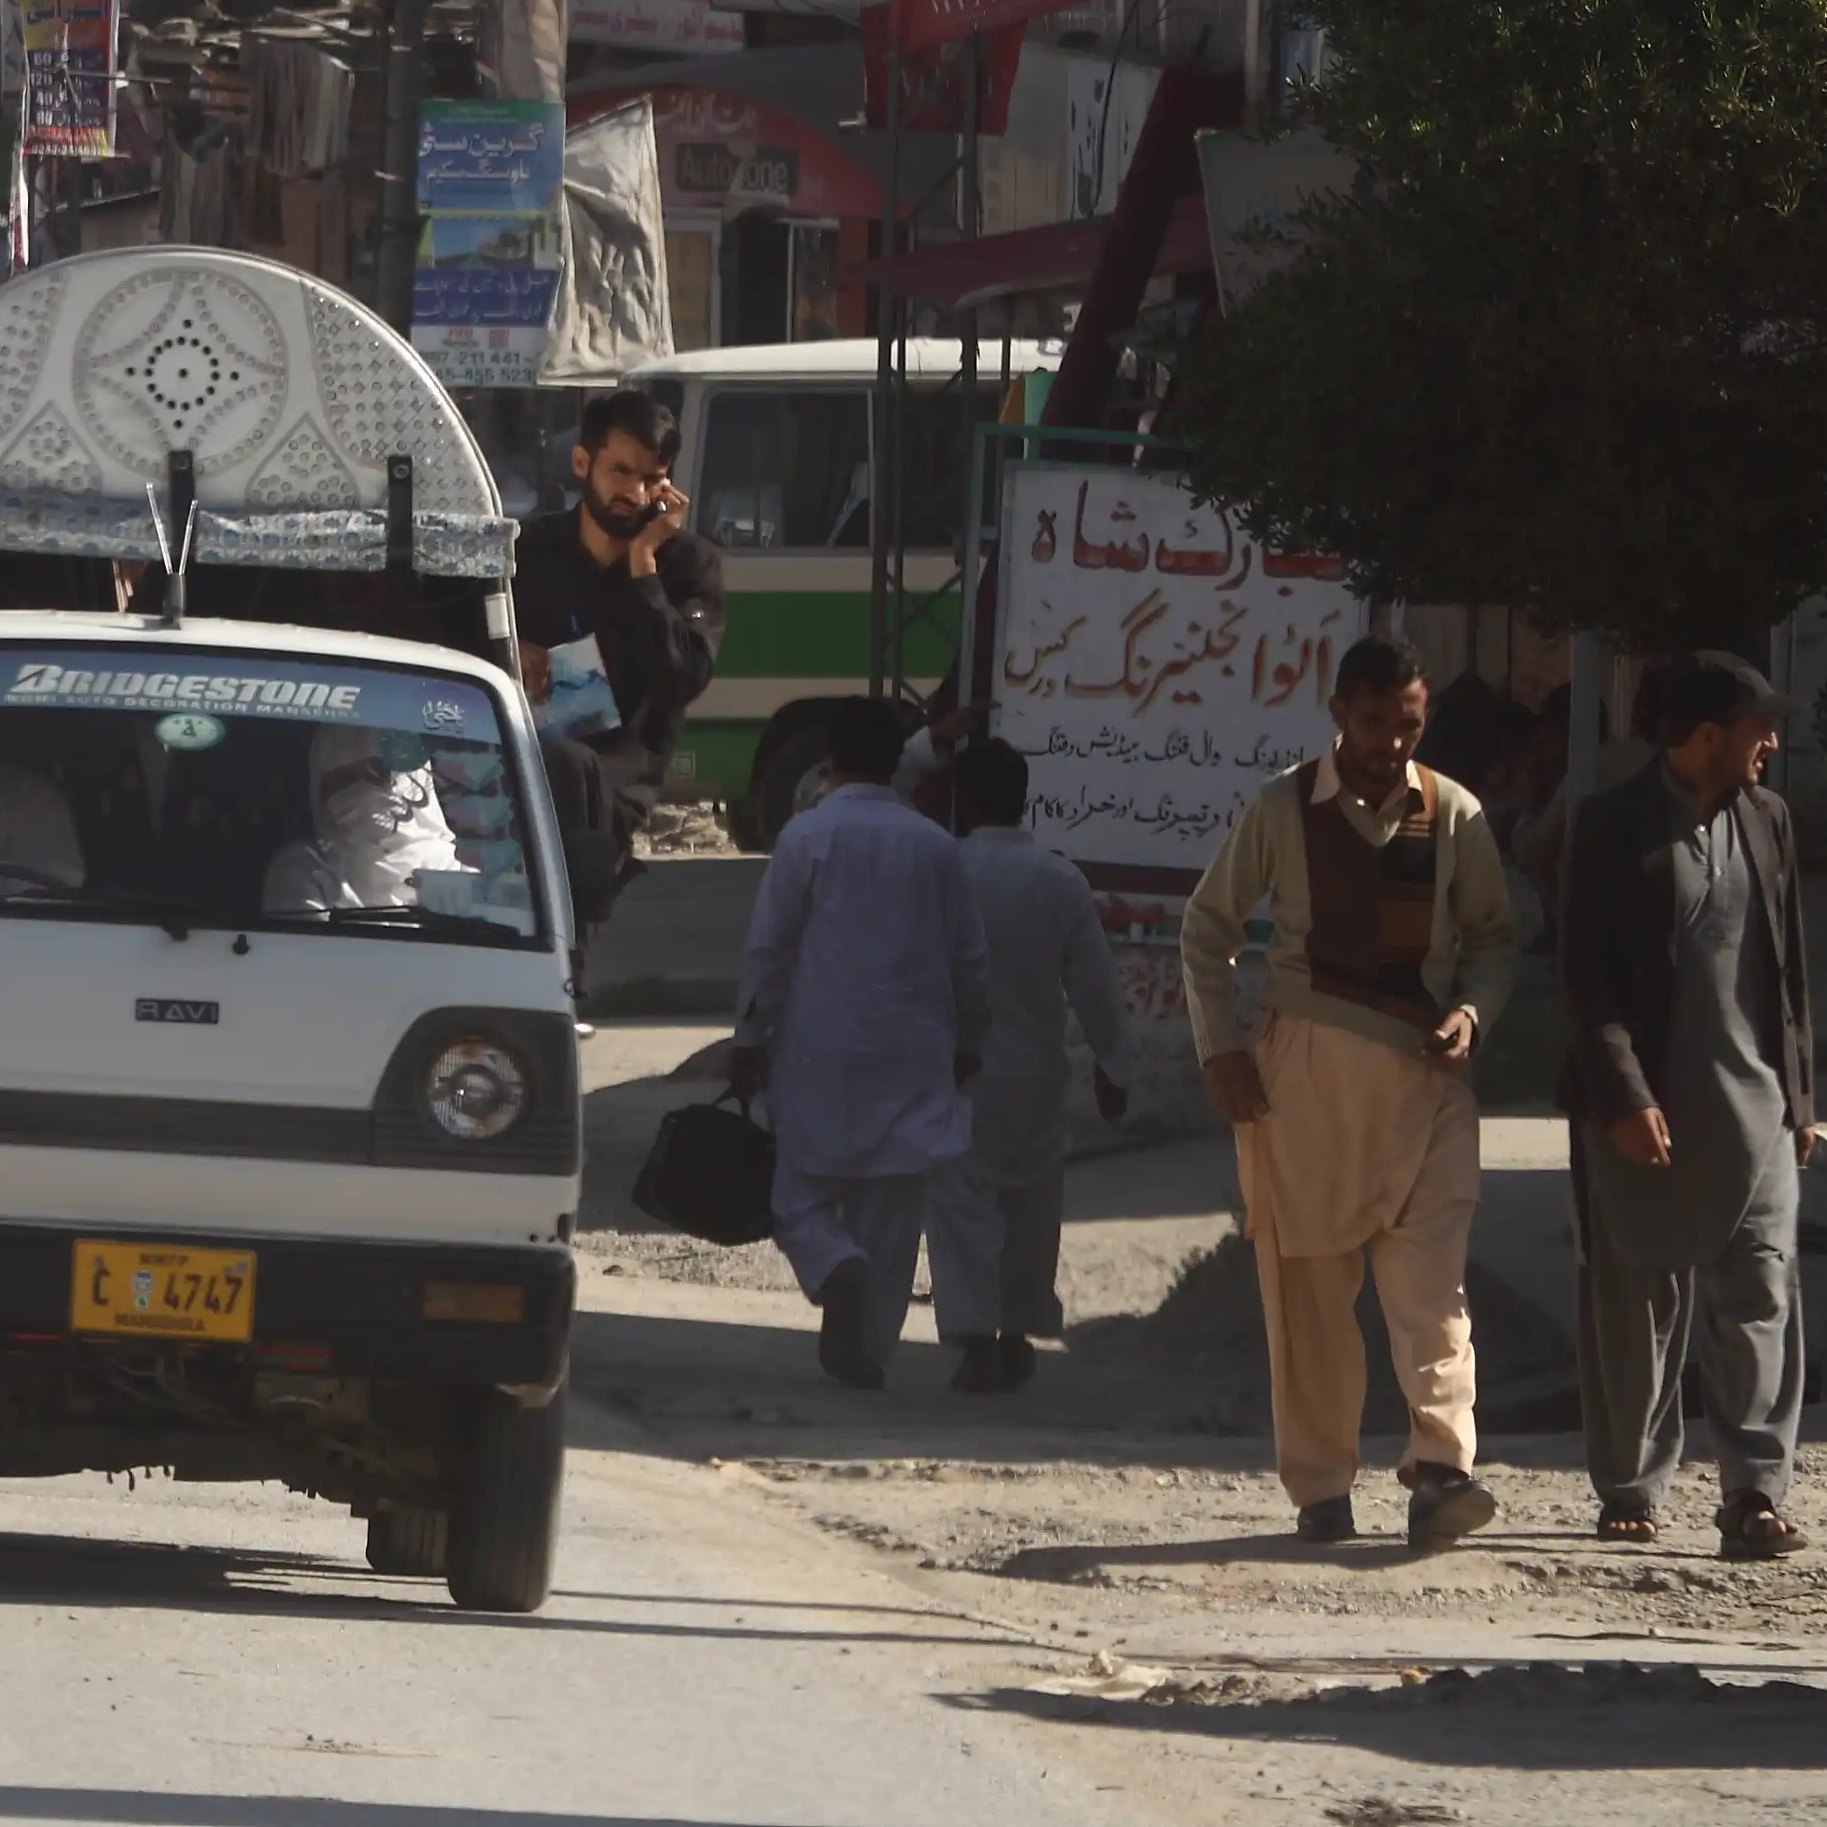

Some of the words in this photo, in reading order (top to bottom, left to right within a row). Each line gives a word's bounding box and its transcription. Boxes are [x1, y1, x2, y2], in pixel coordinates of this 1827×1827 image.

[8, 662, 361, 712] BRIDGESTONE
[65, 695, 116, 706] AUTO
[123, 696, 248, 715] DECORATION
[137, 1001, 218, 1021] RAVI
[92, 1267, 111, 1306] C
[163, 1271, 244, 1315] 4747
